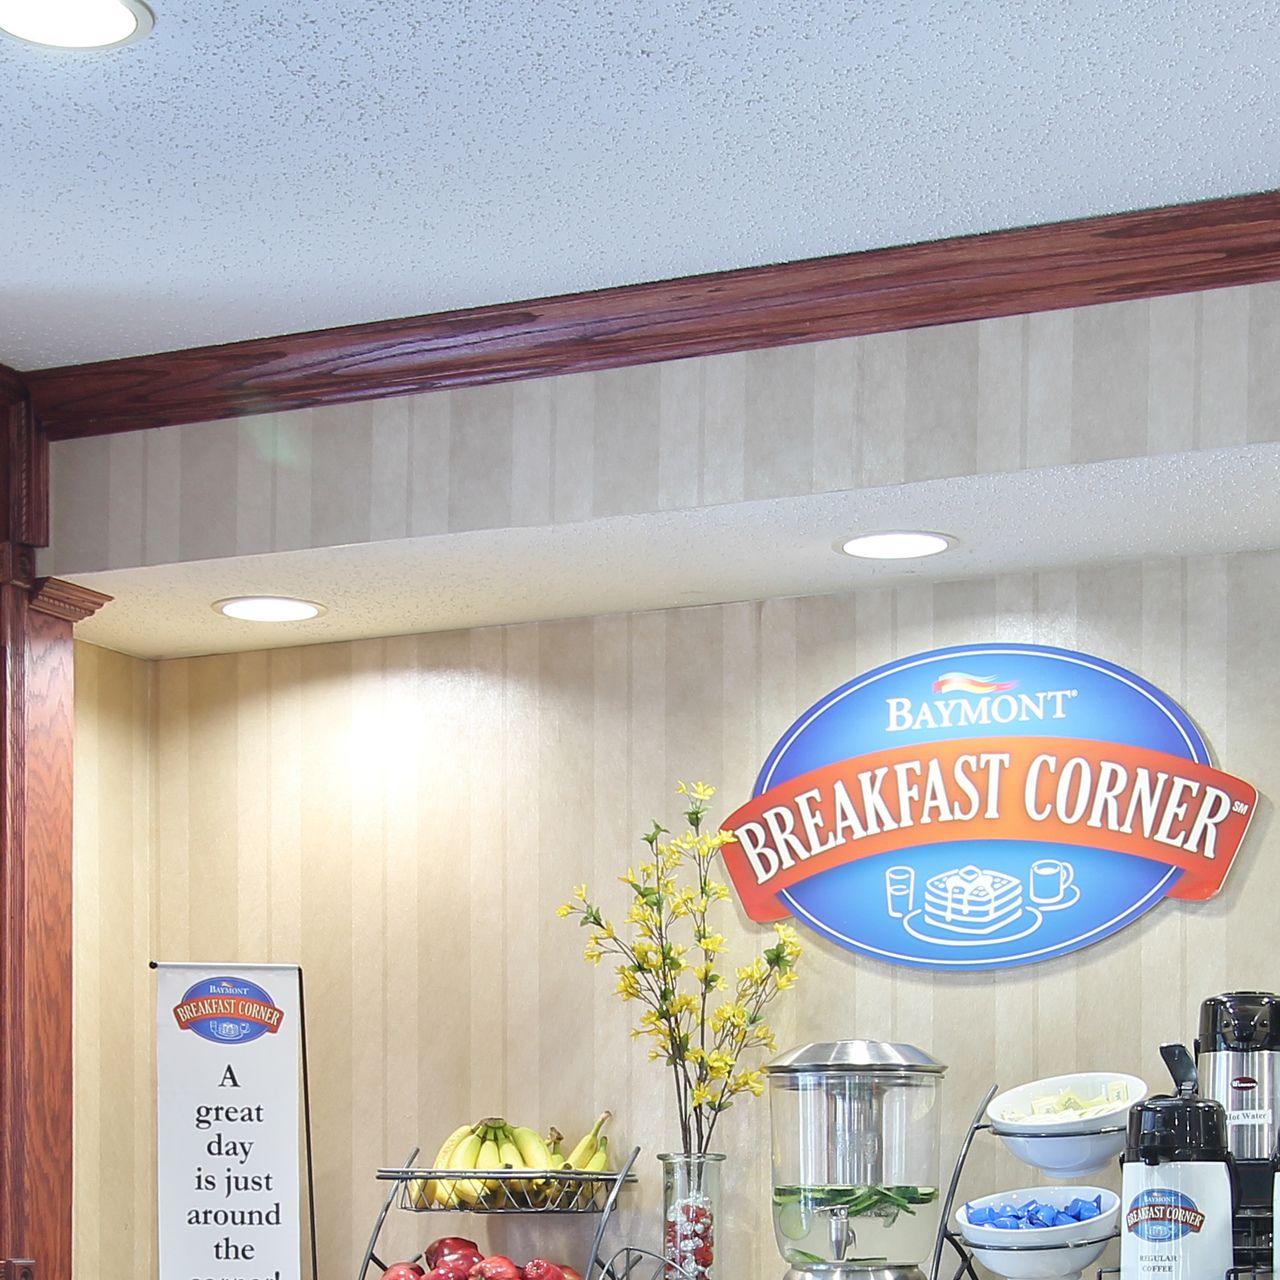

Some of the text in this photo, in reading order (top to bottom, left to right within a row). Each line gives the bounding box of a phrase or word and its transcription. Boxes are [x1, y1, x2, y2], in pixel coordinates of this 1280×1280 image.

[885, 690, 1073, 732] BAYMONT
[735, 754, 1010, 884] BREAKFAST
[1024, 755, 1231, 860] CORNER
[209, 985, 249, 995] BAYMONT
[177, 999, 280, 1026] BREAKFAST CORNER
[218, 1064, 241, 1088] A
[195, 1104, 264, 1130] great
[1242, 1112, 1266, 1120] Water
[206, 1132, 254, 1165] day
[194, 1166, 273, 1199] is just
[186, 1202, 282, 1226] around
[1127, 1206, 1202, 1228] BREAKFAST CORNER
[213, 1237, 255, 1261] the
[1142, 1265, 1173, 1273] COFFEE
